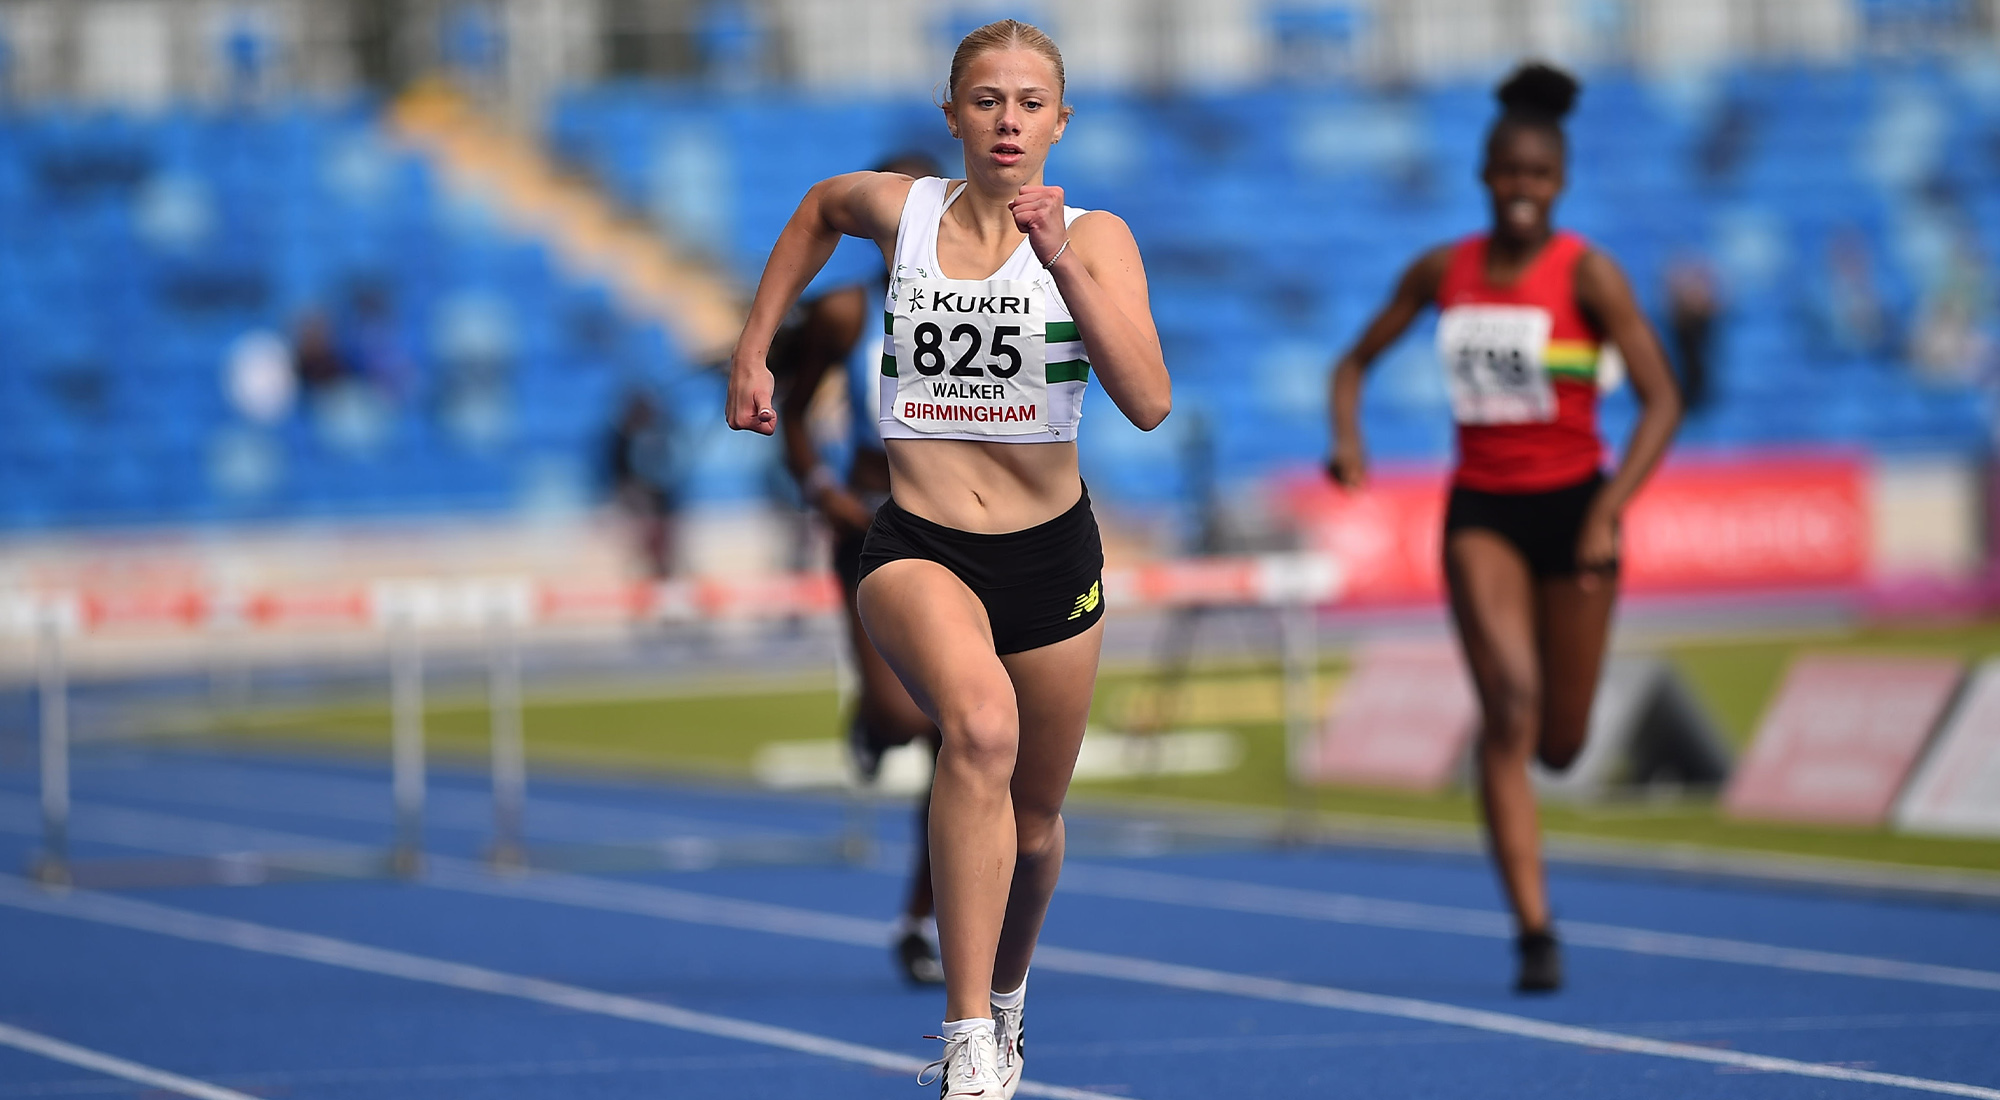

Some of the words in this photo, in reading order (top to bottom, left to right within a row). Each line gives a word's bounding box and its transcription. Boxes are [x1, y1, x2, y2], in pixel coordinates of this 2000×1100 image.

[932, 291, 1030, 314] KUKRI
[913, 322, 1022, 379] 825
[932, 382, 1005, 400] WALKER
[904, 402, 1036, 422] BIRMINGHAM
